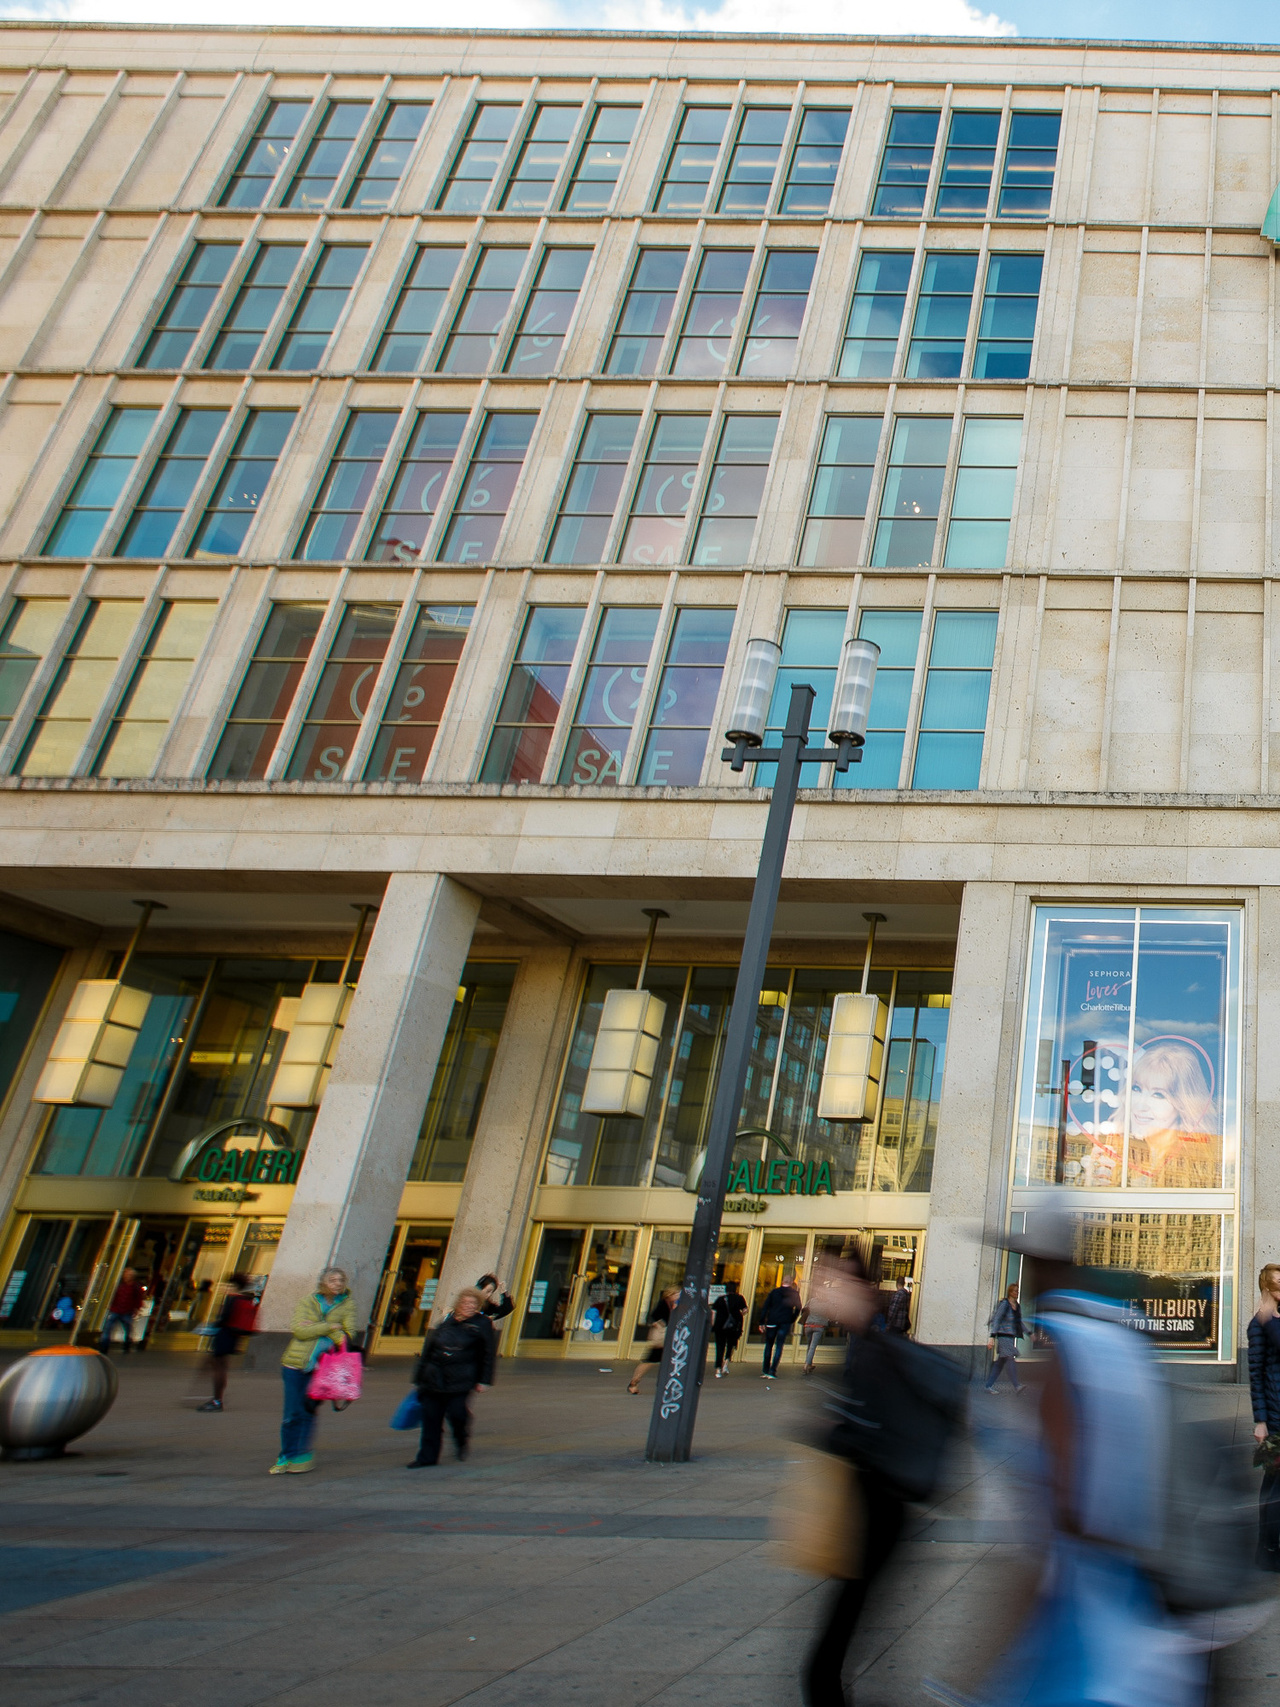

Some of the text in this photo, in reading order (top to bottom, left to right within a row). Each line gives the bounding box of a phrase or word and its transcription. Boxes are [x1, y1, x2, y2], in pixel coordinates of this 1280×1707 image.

[314, 746, 416, 780] SE
[574, 749, 673, 785] SAE
[1089, 970, 1131, 978] SEPHORA
[1085, 980, 1118, 1002] Loves
[198, 1147, 300, 1183] GALERI
[1143, 1299, 1207, 1317] TILBURY
[1147, 1319, 1165, 1331] THE
[1166, 1319, 1195, 1331] STARS
